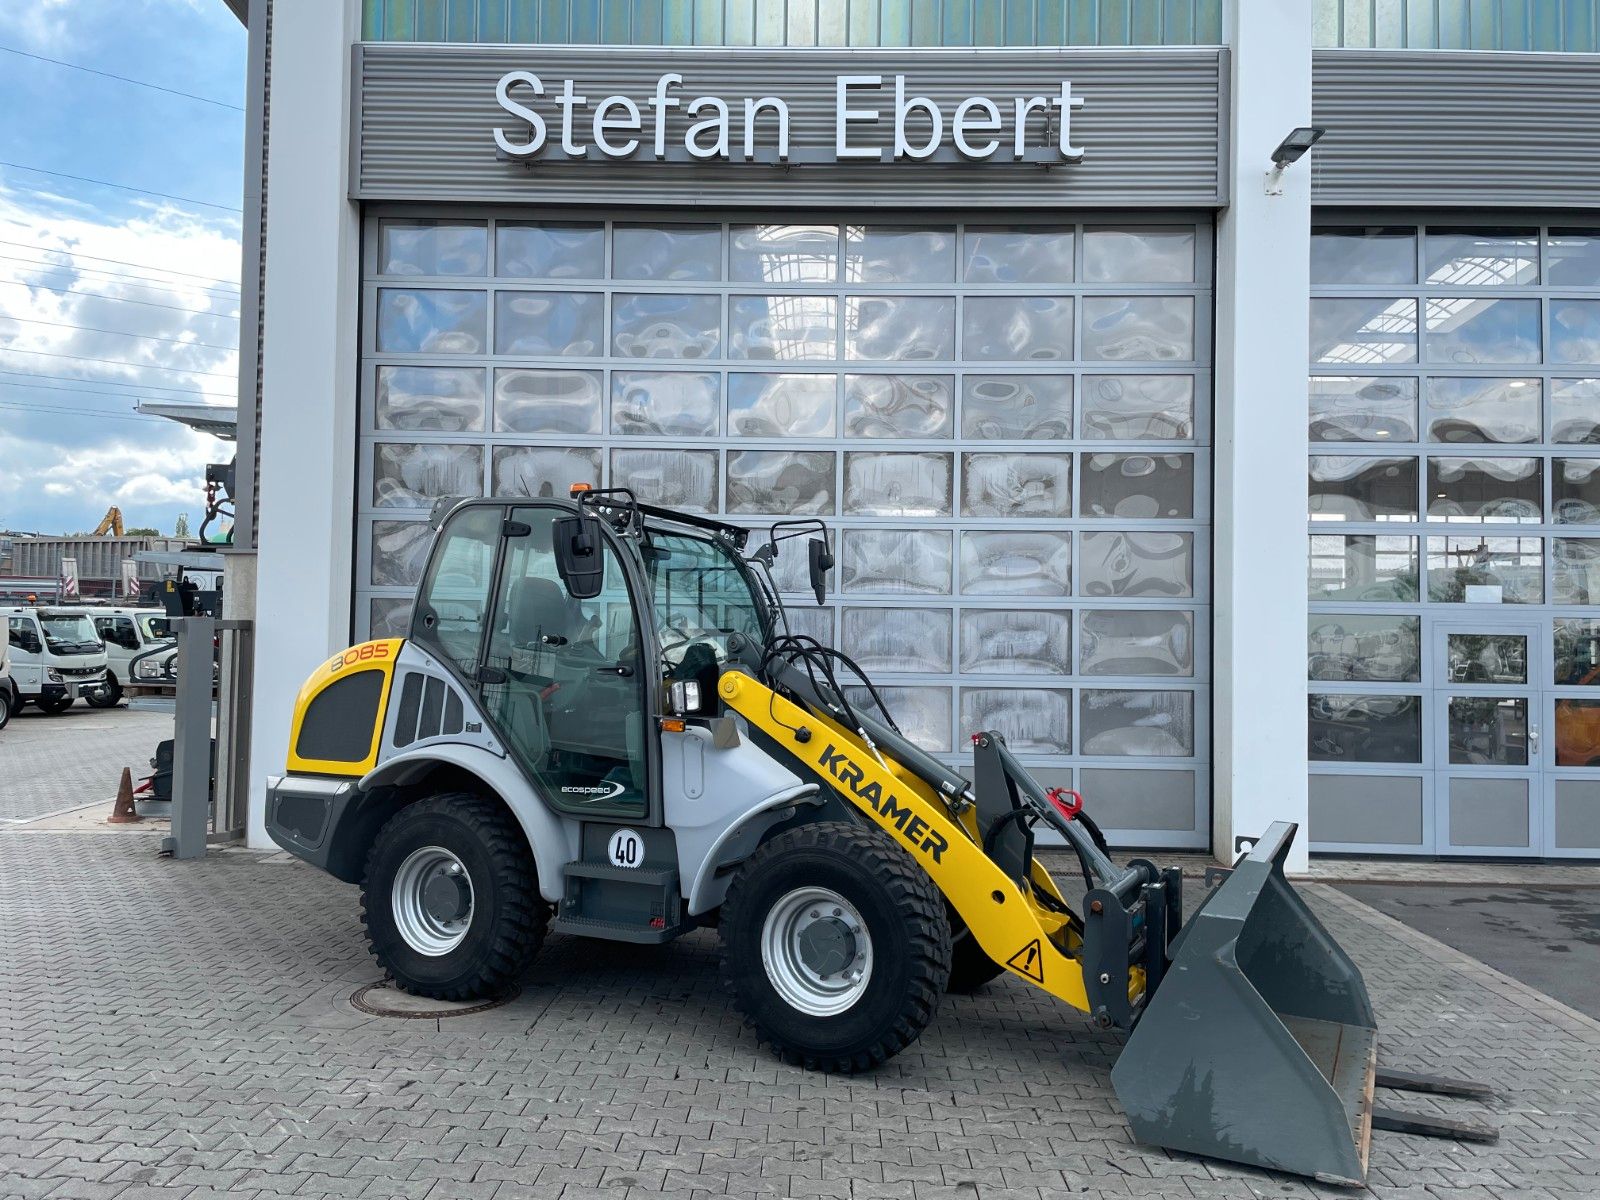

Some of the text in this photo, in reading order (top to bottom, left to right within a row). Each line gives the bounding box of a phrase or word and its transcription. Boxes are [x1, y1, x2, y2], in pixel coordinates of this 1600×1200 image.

[493, 70, 1085, 161] Stefan Ebert
[331, 643, 389, 671] 8085
[561, 786, 610, 794] ecospeed
[818, 743, 949, 865] KRAMER
[615, 836, 636, 864] 40
